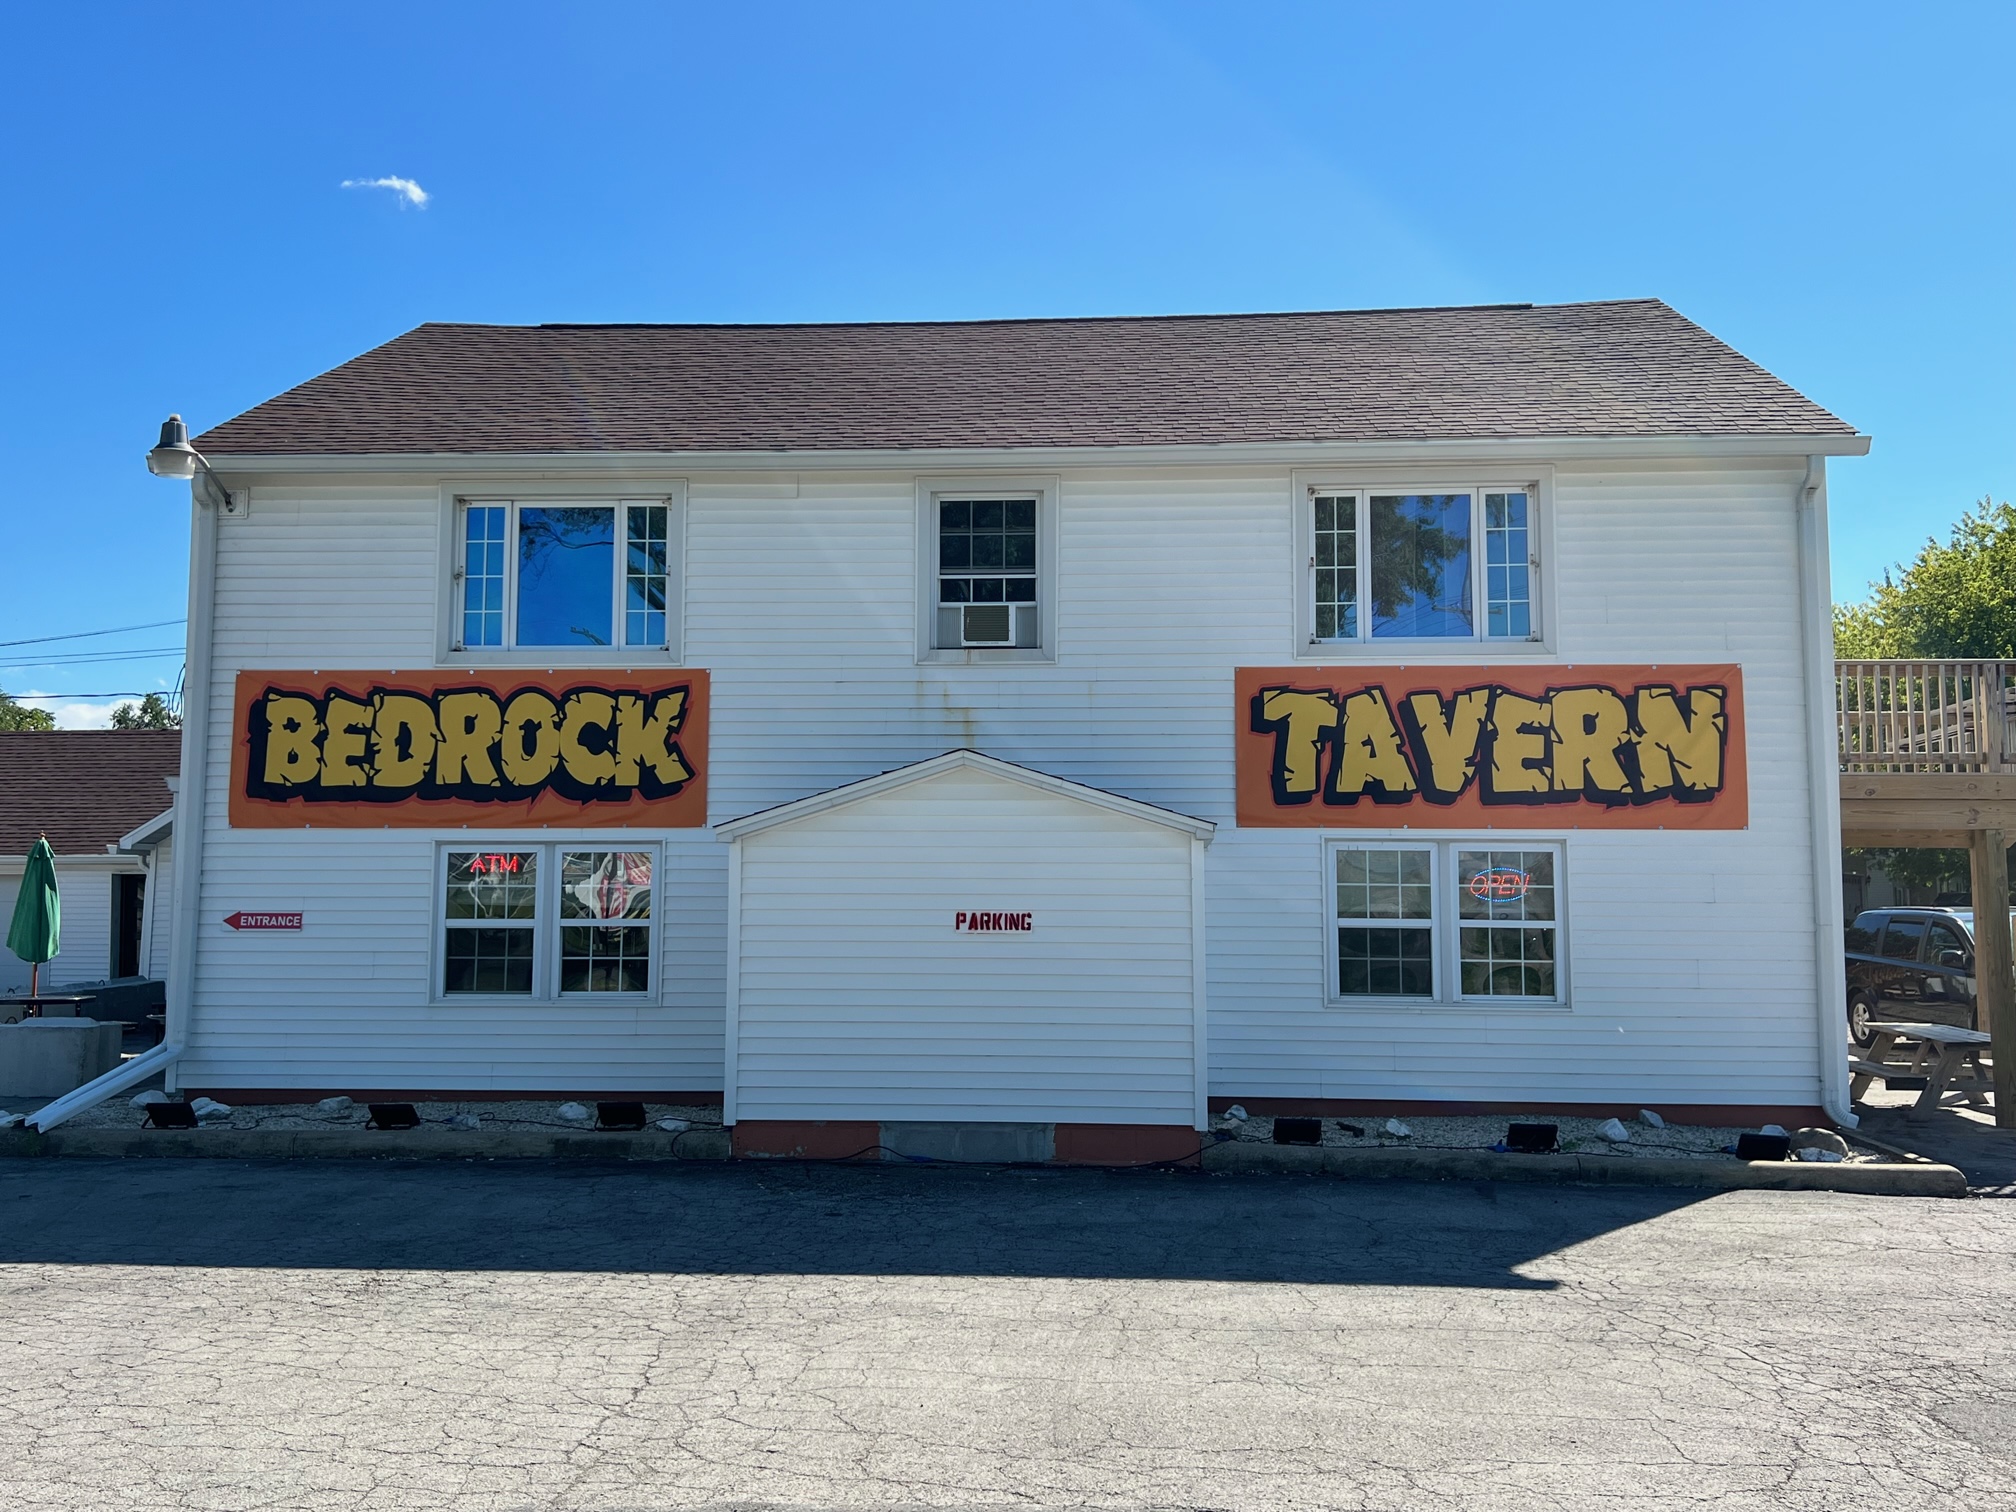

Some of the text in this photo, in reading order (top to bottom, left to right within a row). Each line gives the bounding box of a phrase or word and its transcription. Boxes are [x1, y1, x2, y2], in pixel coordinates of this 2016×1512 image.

[262, 691, 693, 788] BEDROCK
[1262, 688, 1724, 793] TAVERN
[469, 854, 519, 873] ATM
[1470, 874, 1530, 895] OPEN
[240, 916, 301, 926] ENTRANCE
[955, 912, 1032, 931] PARKING
